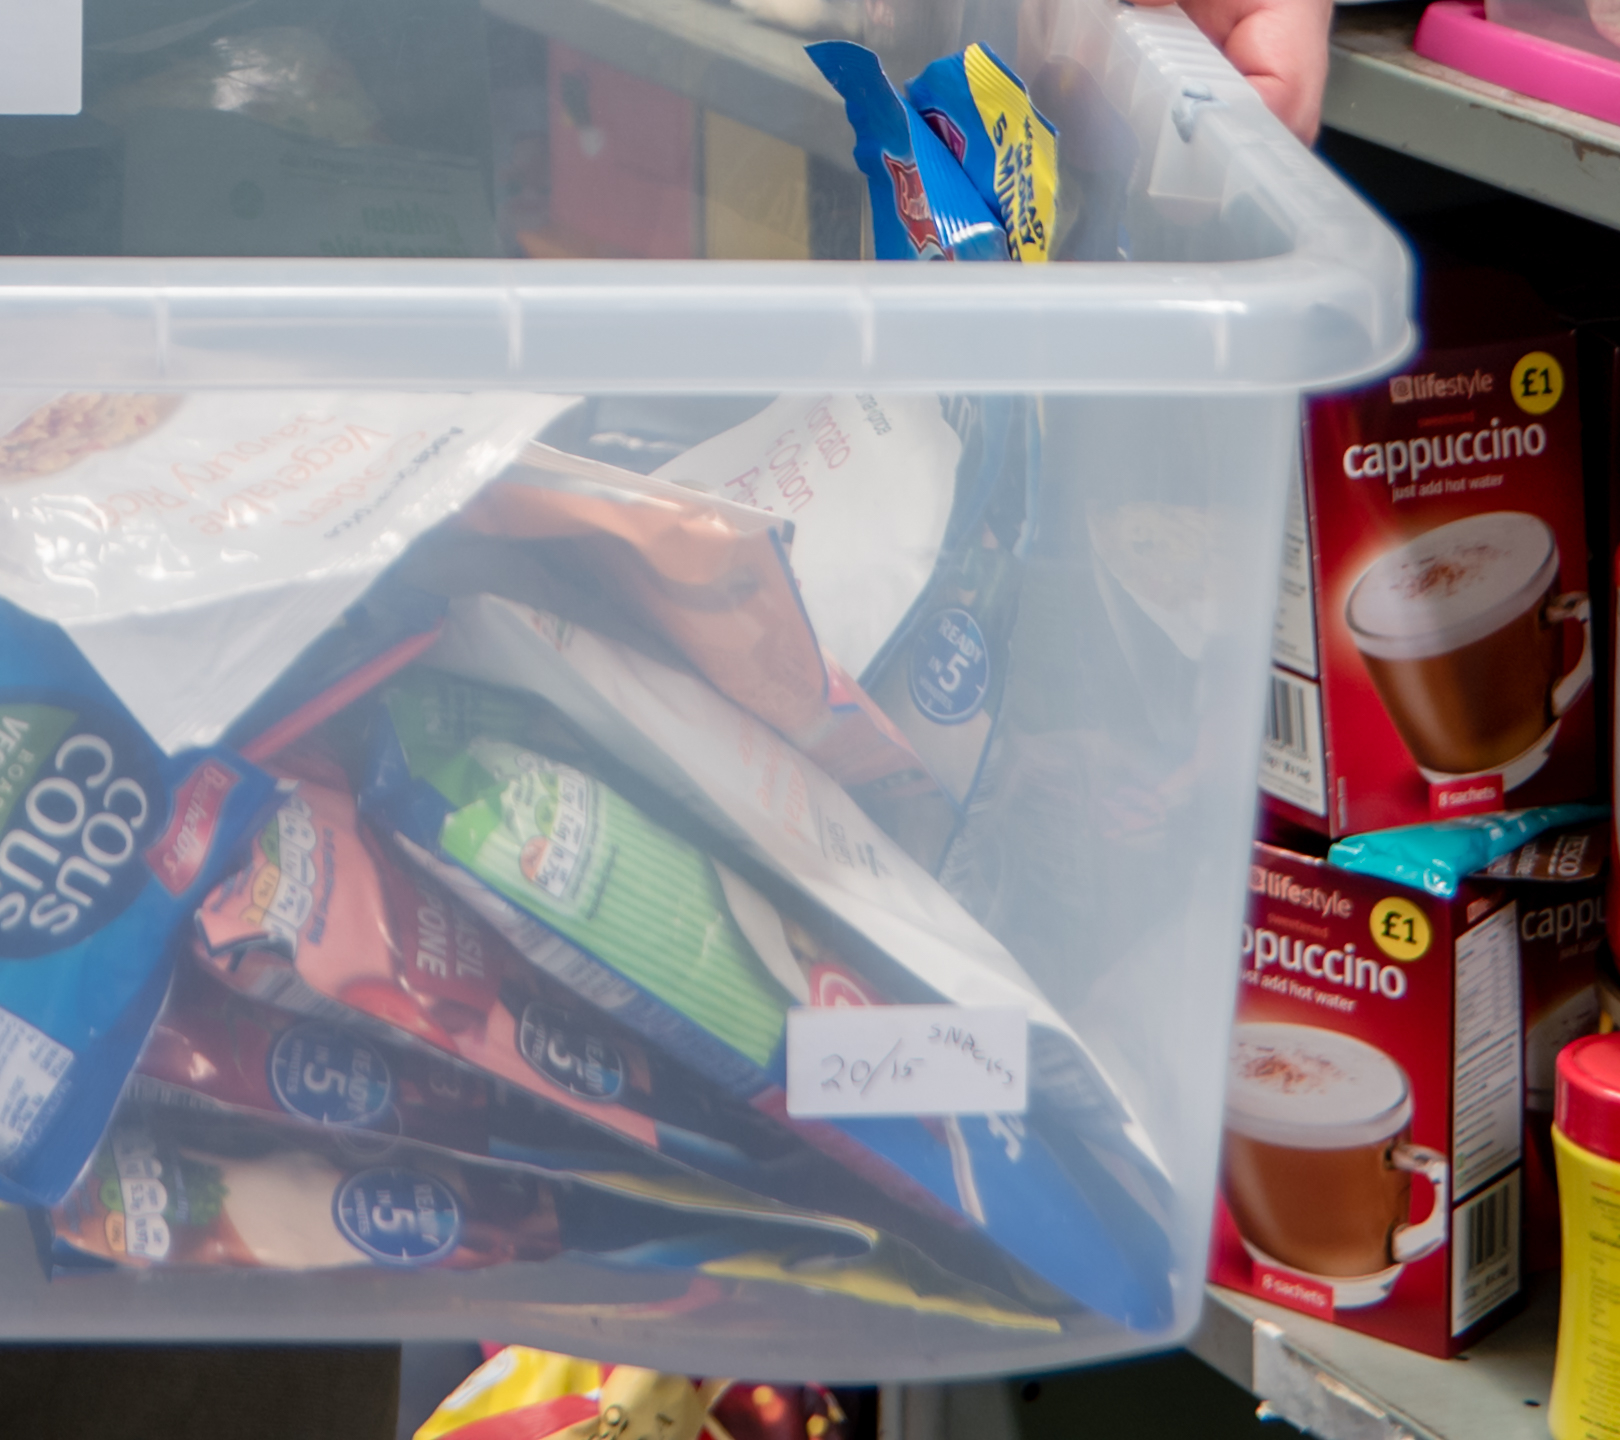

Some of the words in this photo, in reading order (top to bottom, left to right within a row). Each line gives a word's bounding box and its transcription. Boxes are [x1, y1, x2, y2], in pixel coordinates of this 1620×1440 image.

[1412, 369, 1493, 402] lifestyle
[1520, 366, 1554, 397] £1
[1343, 417, 1547, 484] cappuccino
[768, 443, 814, 513] Onion
[1392, 481, 1414, 502] just
[1417, 477, 1443, 496] add
[1445, 477, 1465, 494] hot
[1467, 471, 1505, 491] water
[938, 618, 984, 664] READY
[928, 655, 943, 674] IN
[937, 652, 970, 693] 5
[1438, 789, 1447, 805] 8
[1448, 783, 1497, 804] sachets
[29, 777, 149, 936] COUS
[1265, 871, 1354, 919] lifestyle
[1380, 910, 1419, 945] £1
[1240, 922, 1408, 1000] ppuccino
[1314, 987, 1357, 1011] water
[301, 1062, 345, 1094] 5
[547, 1044, 584, 1081] 5
[819, 1036, 926, 1101] 20/15
[375, 1188, 390, 1205] IN
[372, 1207, 415, 1234] 5
